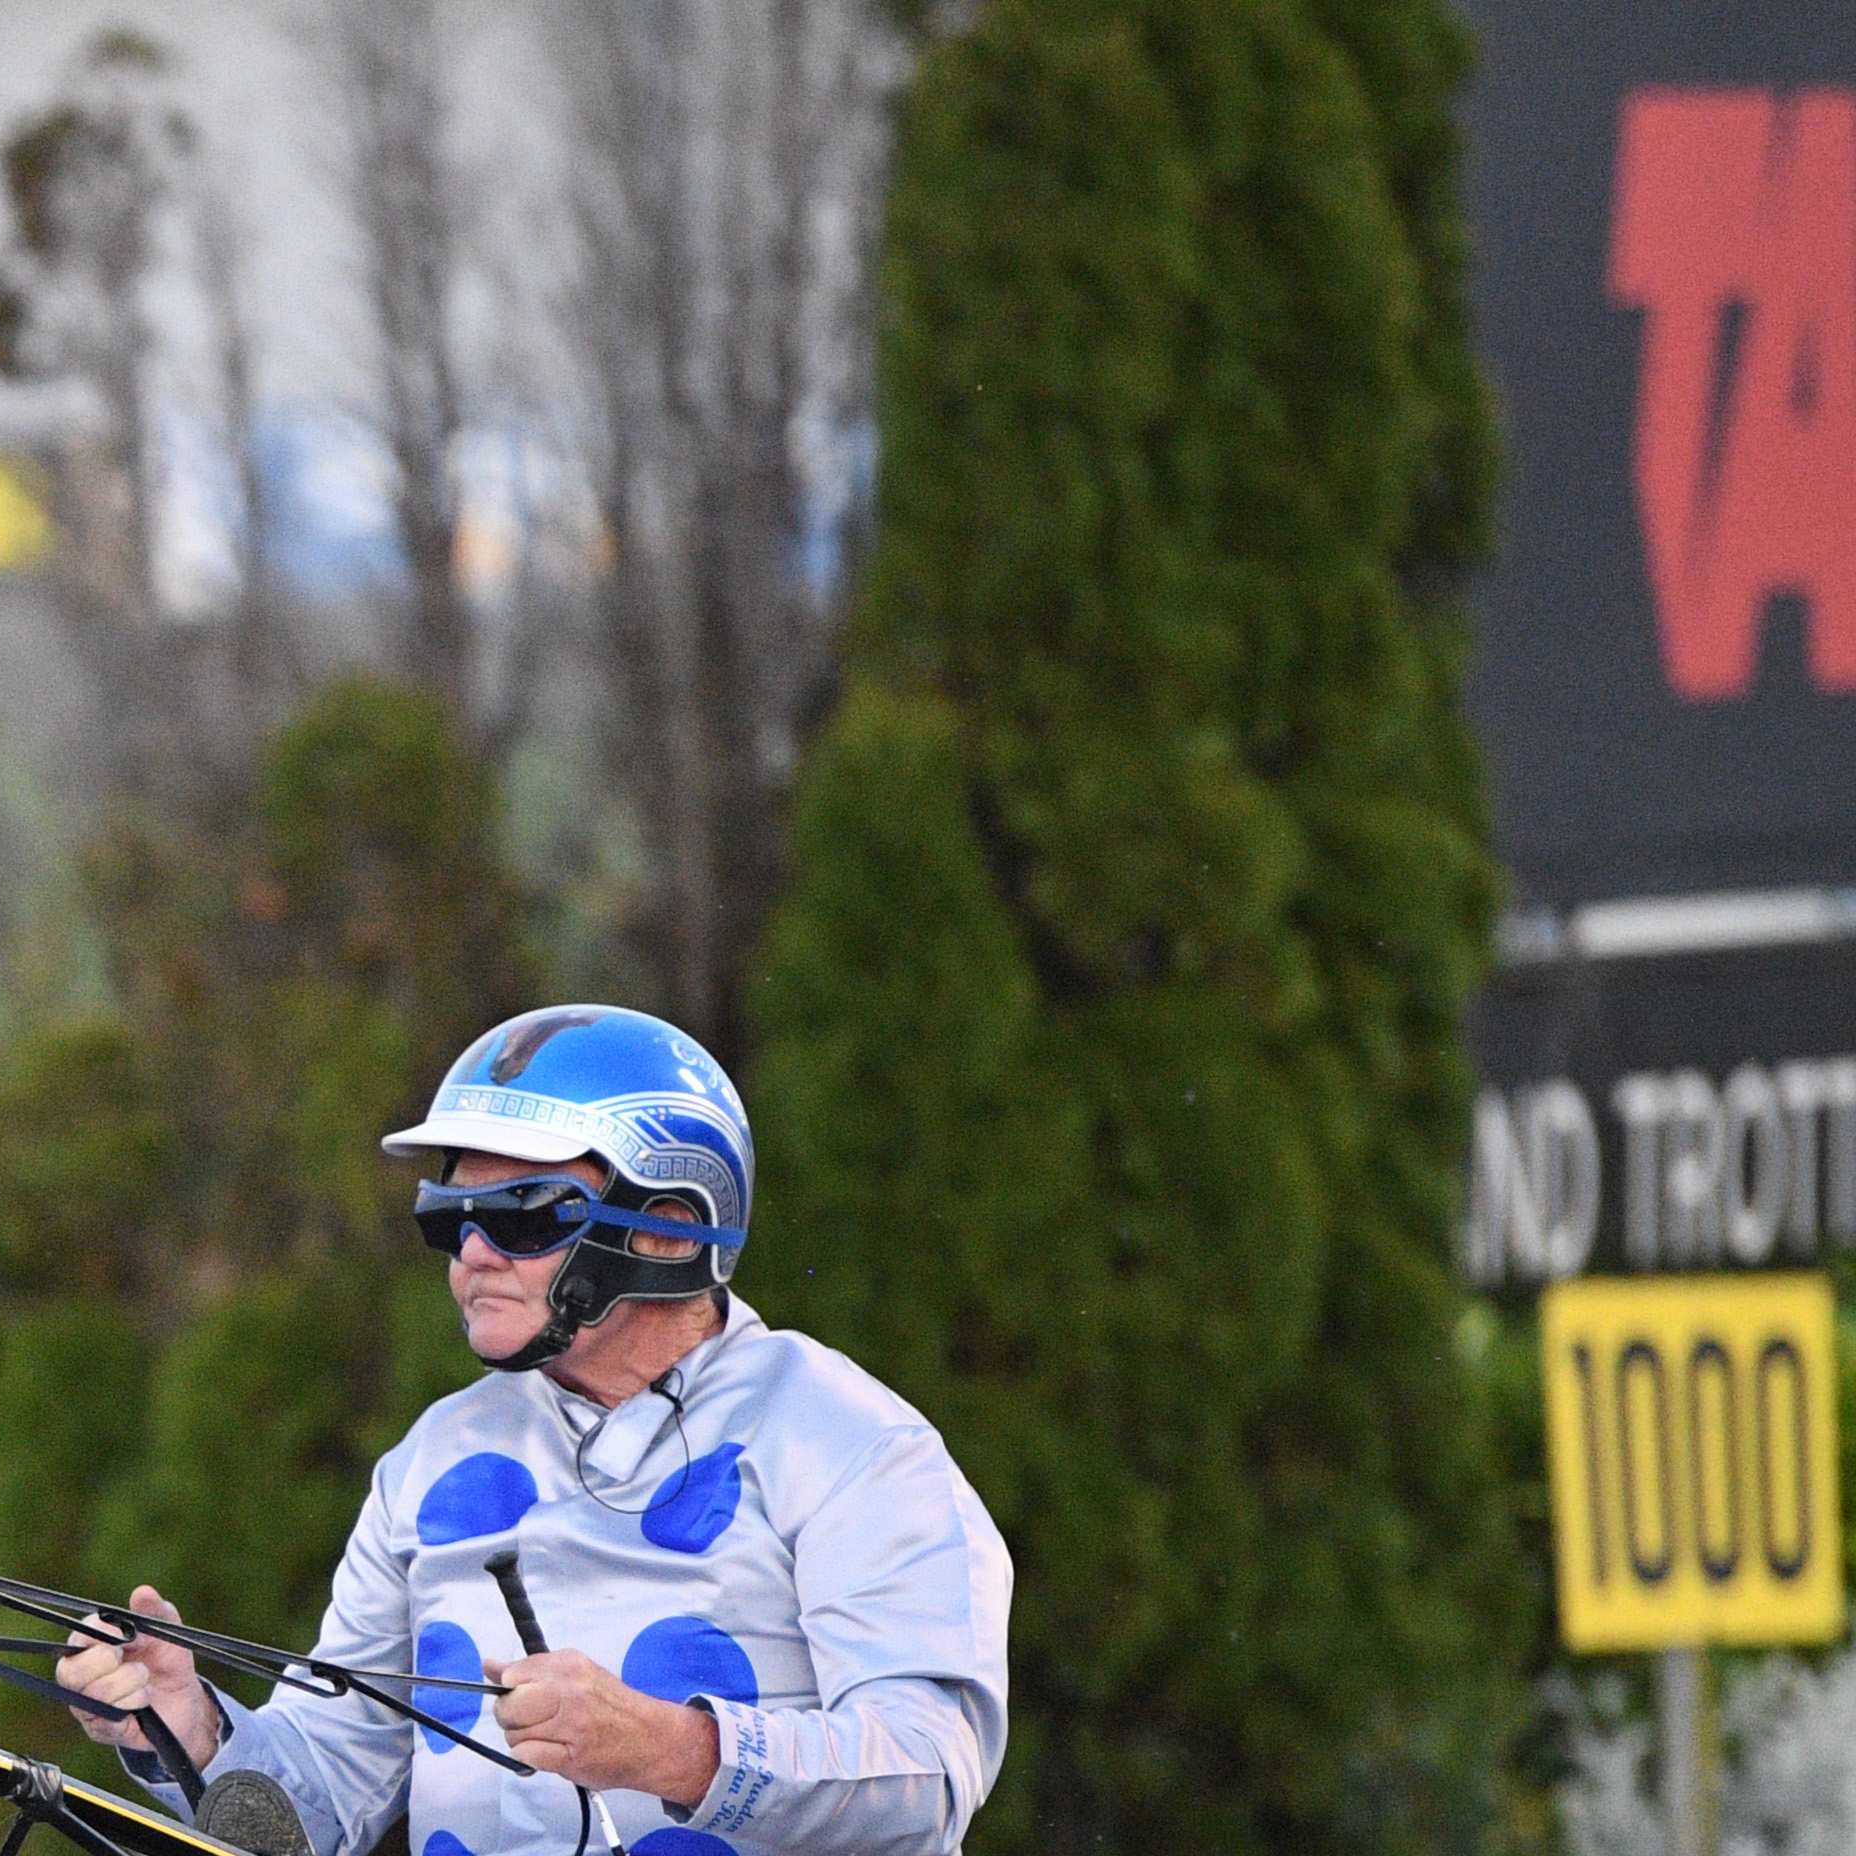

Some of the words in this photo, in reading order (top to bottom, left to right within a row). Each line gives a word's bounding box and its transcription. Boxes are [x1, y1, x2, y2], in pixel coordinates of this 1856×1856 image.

[1568, 1334, 1815, 1590] 1000
[728, 1722, 753, 1795] Phelan
[725, 1765, 775, 1833] Purdon
